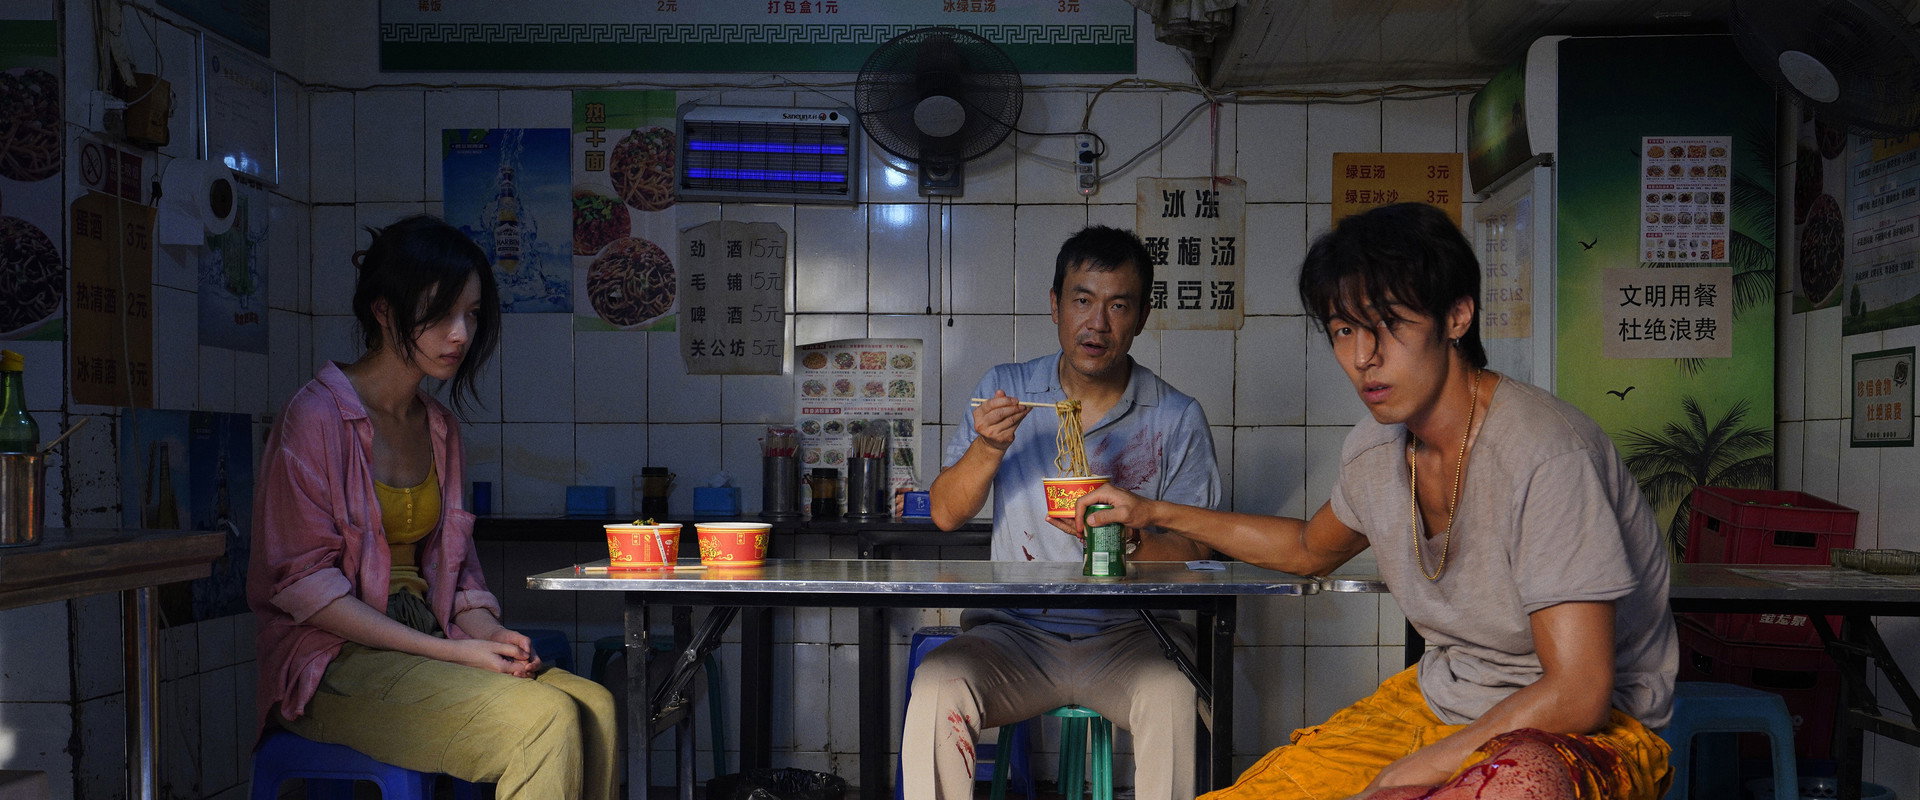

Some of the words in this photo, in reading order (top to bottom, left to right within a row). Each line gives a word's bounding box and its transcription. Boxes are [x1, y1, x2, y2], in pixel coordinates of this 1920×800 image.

[657, 0, 678, 12] 2元
[768, 0, 839, 14] 打包盒1元
[943, 0, 996, 13] 冰绿豆汤
[1057, 0, 1080, 13] 3元
[585, 103, 606, 172] 热干面
[1345, 164, 1385, 179] 绿豆汤
[1427, 165, 1450, 179] 3元
[1162, 189, 1220, 218] 冰冻
[1344, 189, 1399, 204] 绿豆冰沙
[1427, 190, 1449, 204] 3元
[1145, 236, 1236, 266] 酸梅汤
[127, 292, 147, 318] 2元
[1619, 283, 1718, 308] 文明用餐
[750, 304, 783, 323] 5元
[1618, 317, 1717, 342] 杜绝浪费
[691, 339, 746, 357] 关公坊
[751, 339, 782, 358] 5元
[1866, 401, 1902, 421] 杜绝浪费
